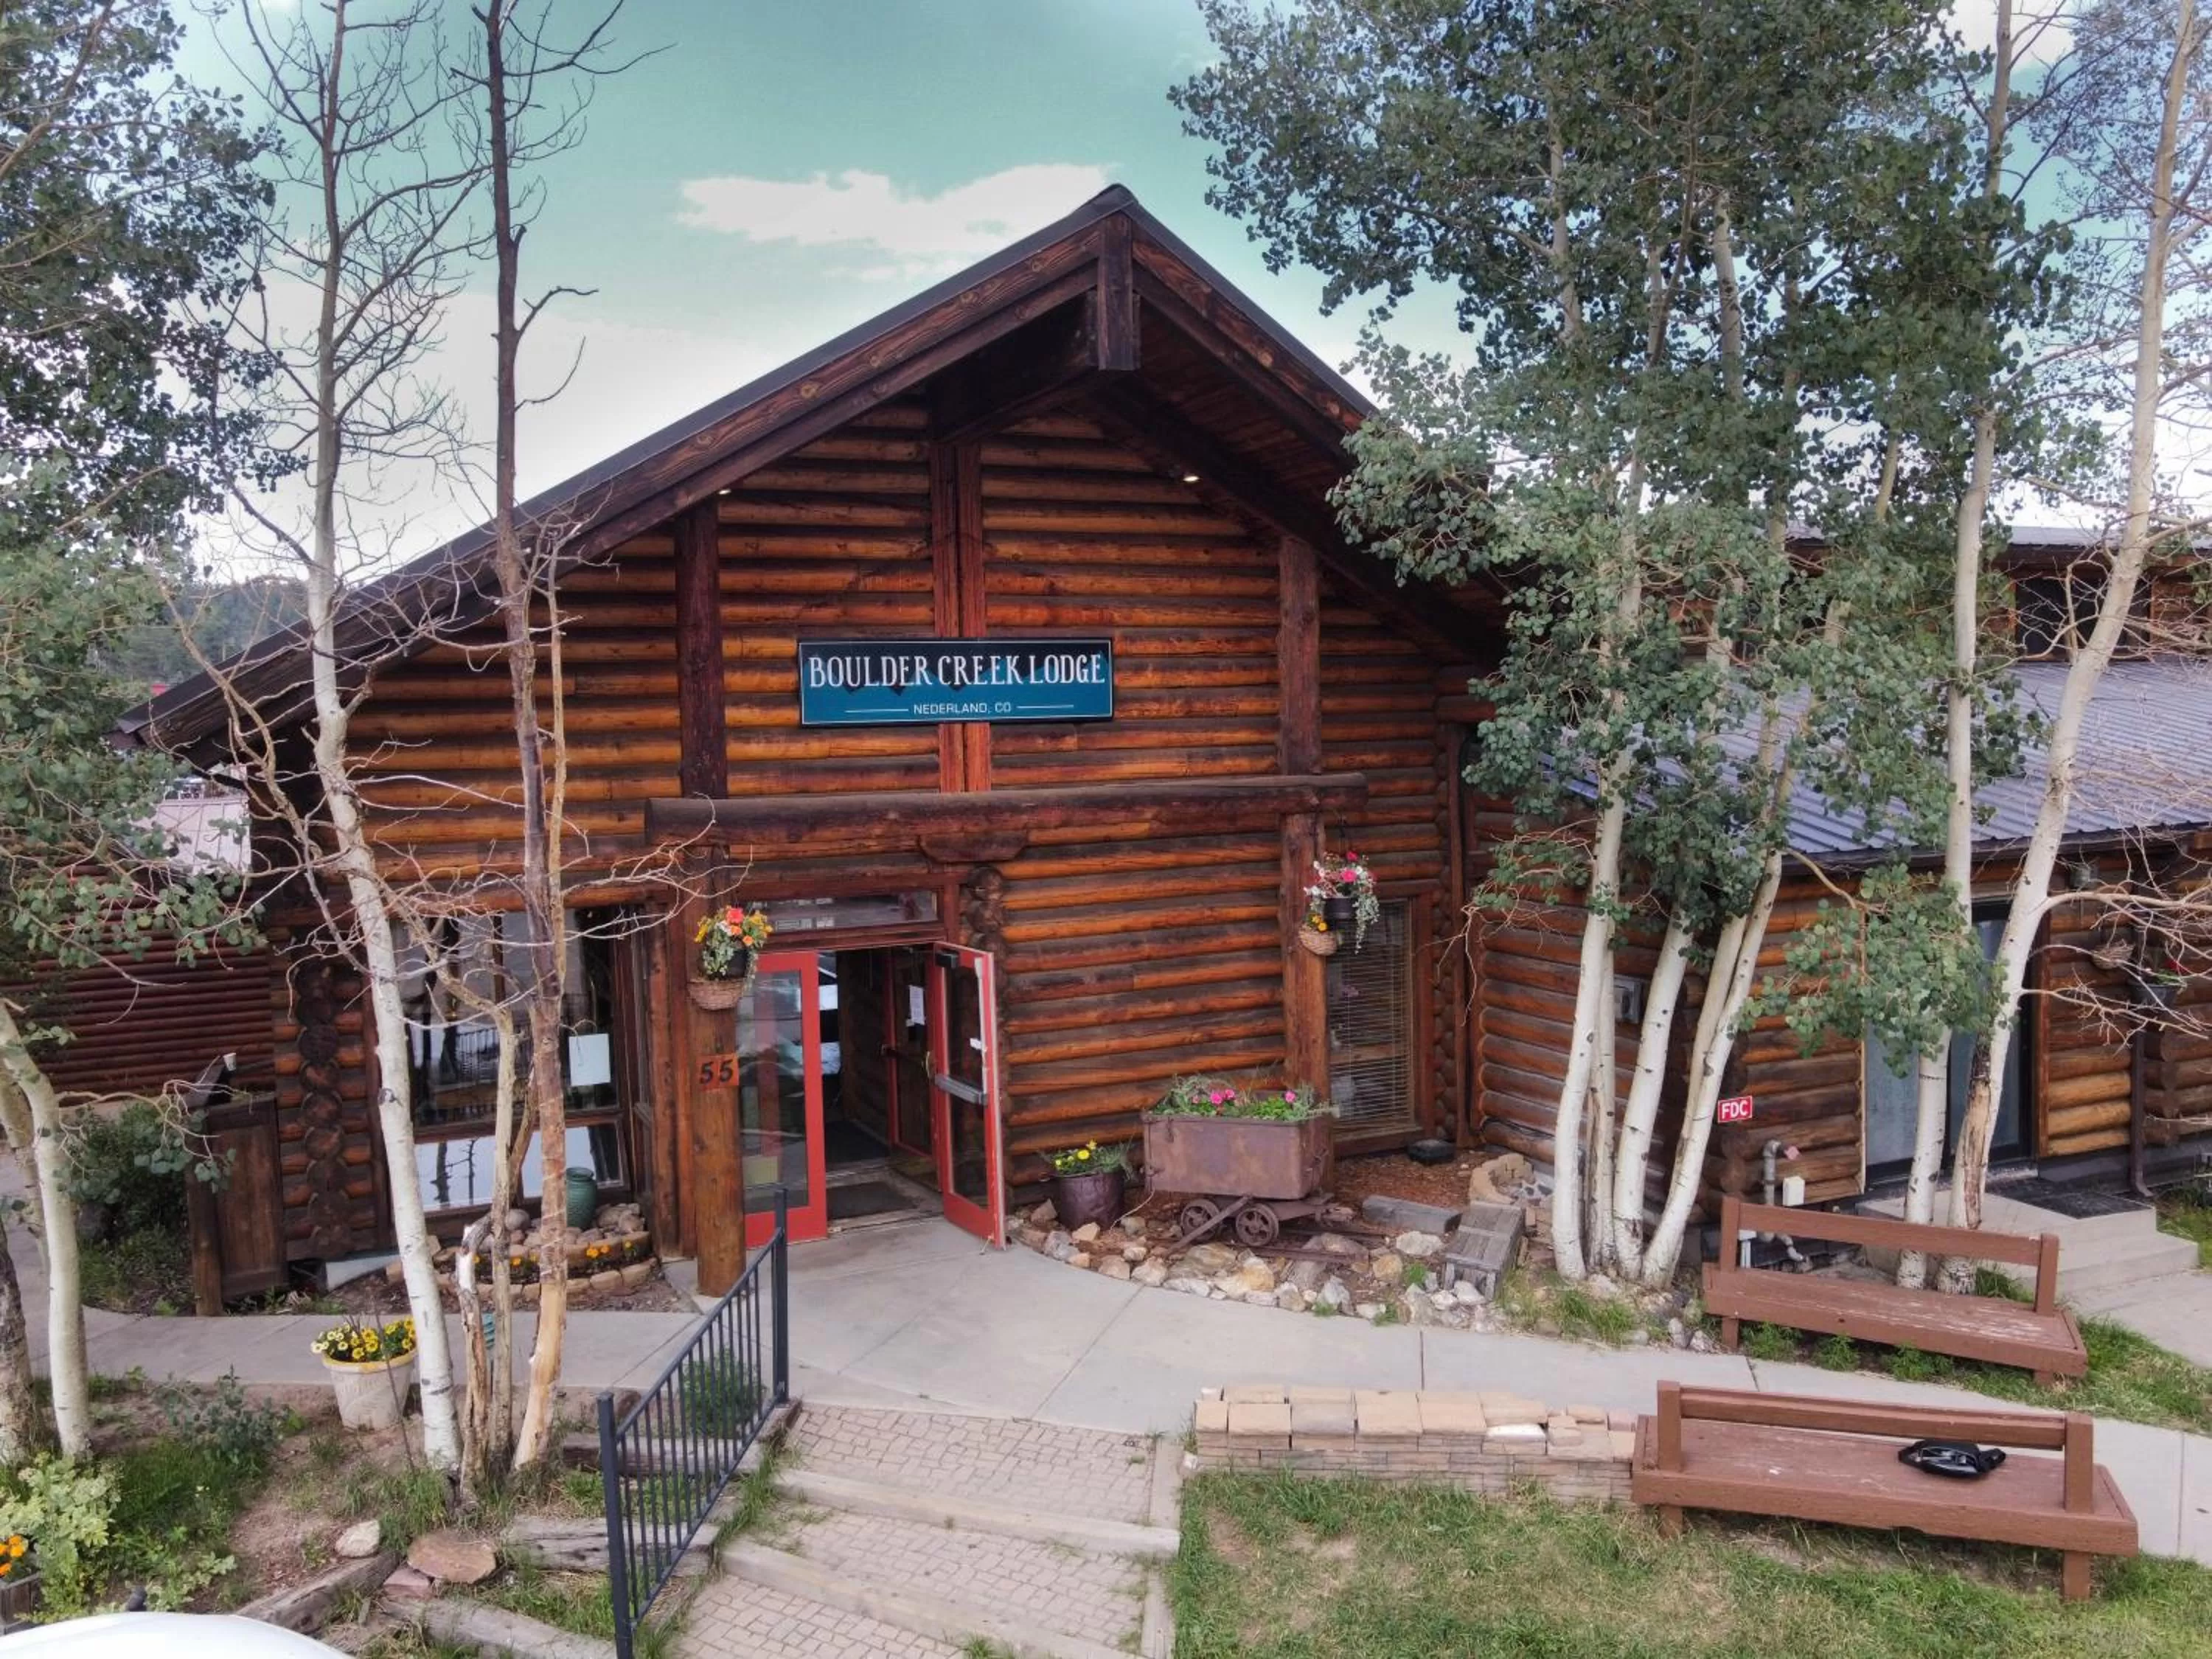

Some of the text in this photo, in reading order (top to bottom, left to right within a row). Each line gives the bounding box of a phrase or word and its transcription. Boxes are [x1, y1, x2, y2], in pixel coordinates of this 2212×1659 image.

[808, 654, 1105, 687] BOULDER CREEK LODGE
[914, 702, 1012, 714] NEDERLAND, CO
[700, 1059, 734, 1085] 55
[1722, 1099, 1748, 1119] FDC
